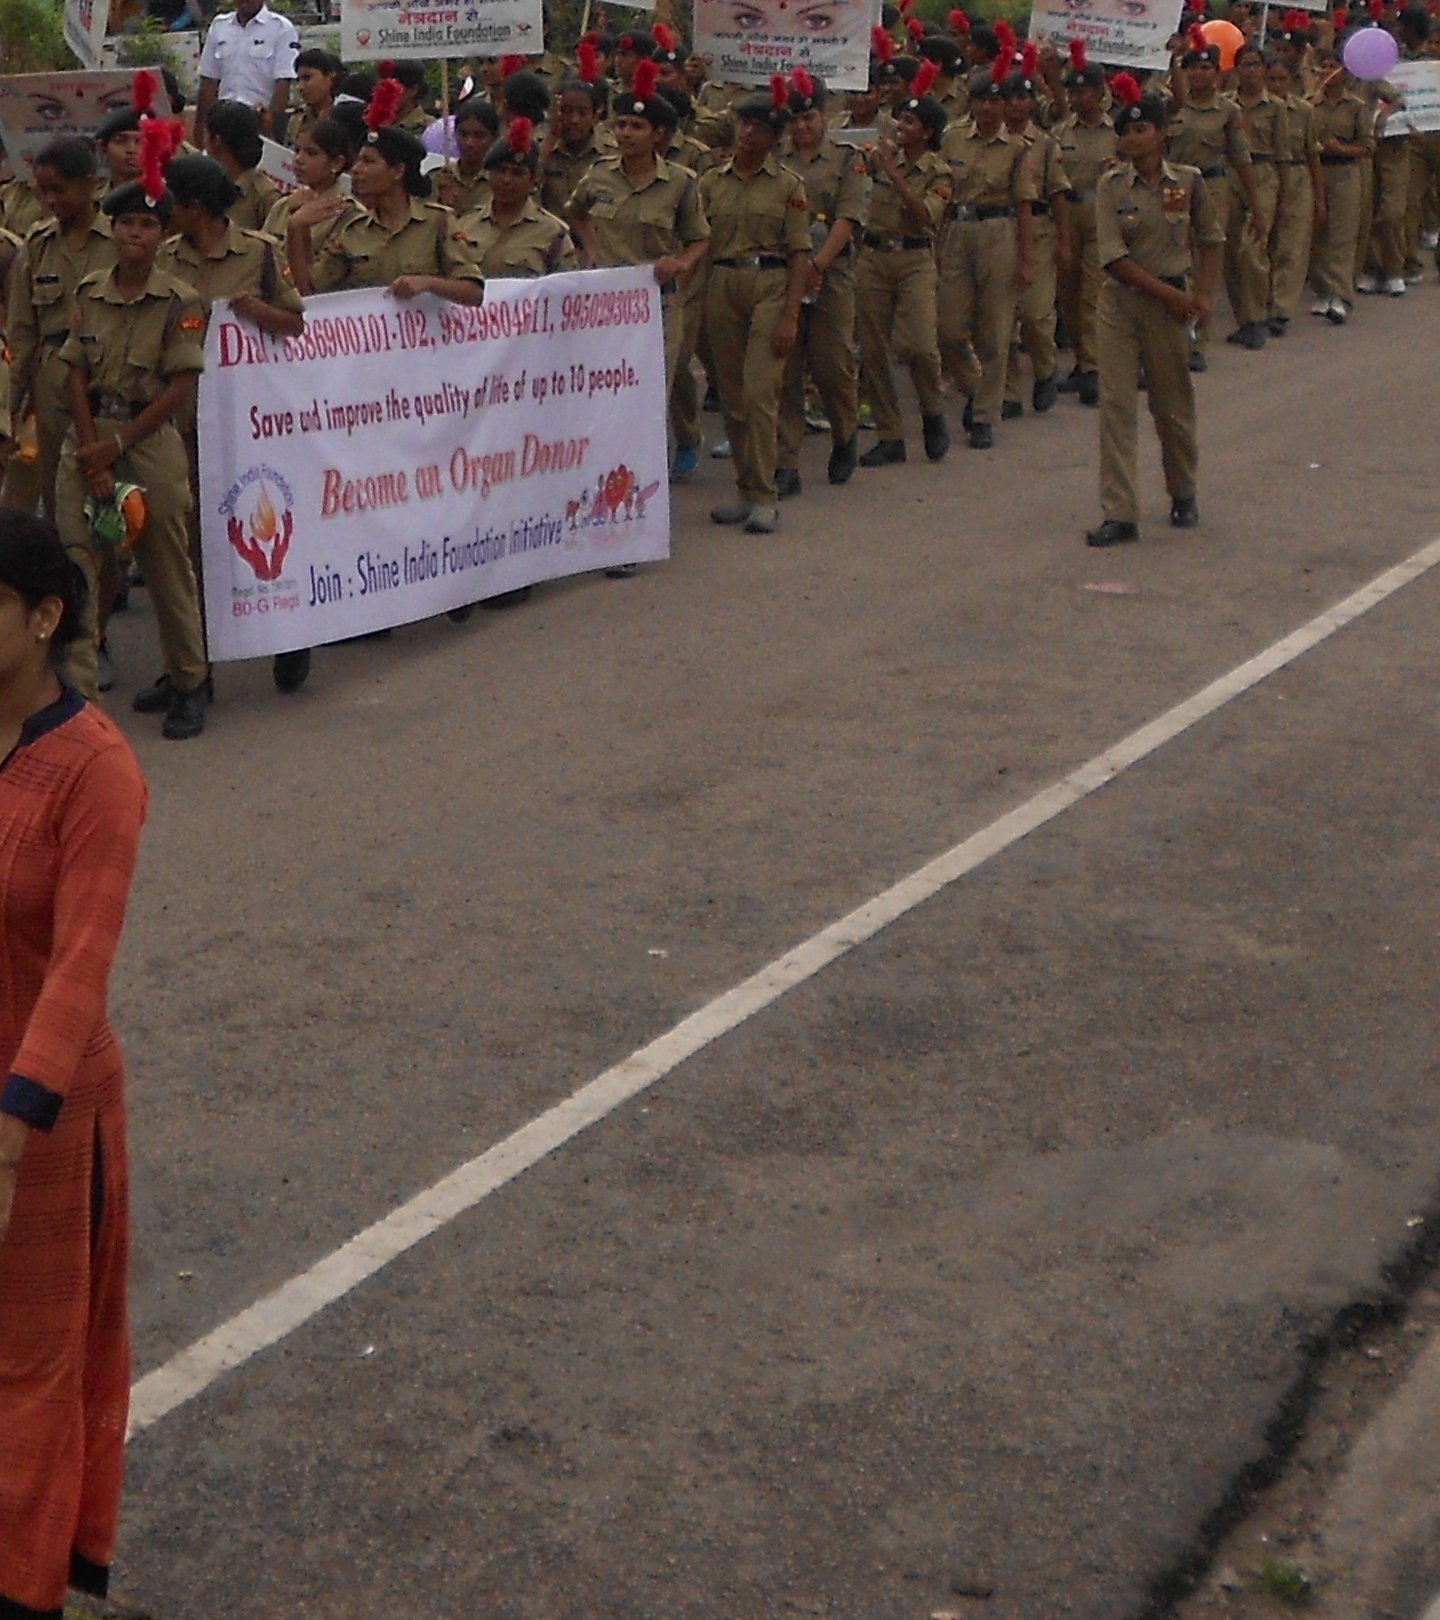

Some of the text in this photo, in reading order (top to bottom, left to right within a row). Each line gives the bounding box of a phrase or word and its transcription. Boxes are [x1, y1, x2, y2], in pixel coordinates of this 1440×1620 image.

[378, 29, 410, 44] Shine
[414, 26, 443, 41] India
[447, 23, 511, 40] Foundation
[249, 358, 639, 440] Save and improve the quality of life of up to 10 people.
[320, 433, 591, 520] Become an Organ Donor
[309, 564, 343, 607] Join
[357, 551, 400, 596] Shine
[403, 539, 439, 580] India
[442, 528, 506, 575] Foundation
[509, 512, 563, 556] Initiative
